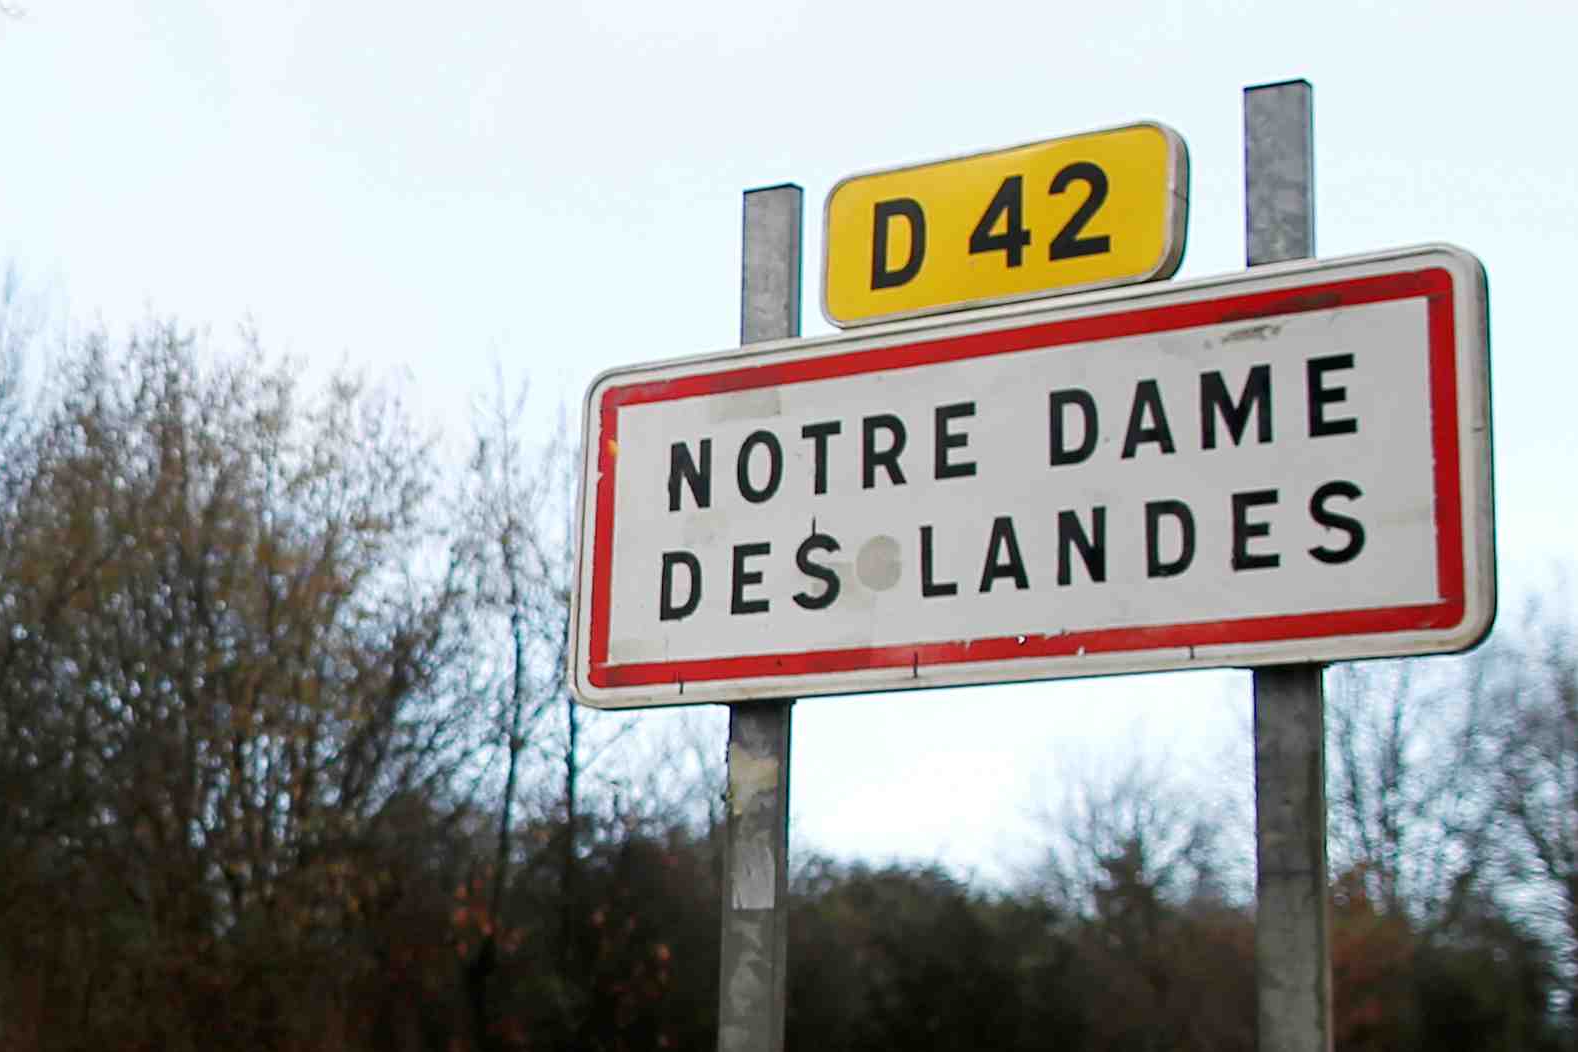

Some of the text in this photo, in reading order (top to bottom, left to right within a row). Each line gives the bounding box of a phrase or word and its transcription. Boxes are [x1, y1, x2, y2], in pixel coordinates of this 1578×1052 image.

[870, 162, 1111, 290] D 42
[667, 353, 1359, 512] NOTRE DAME
[659, 480, 1366, 622] DES LANDES
